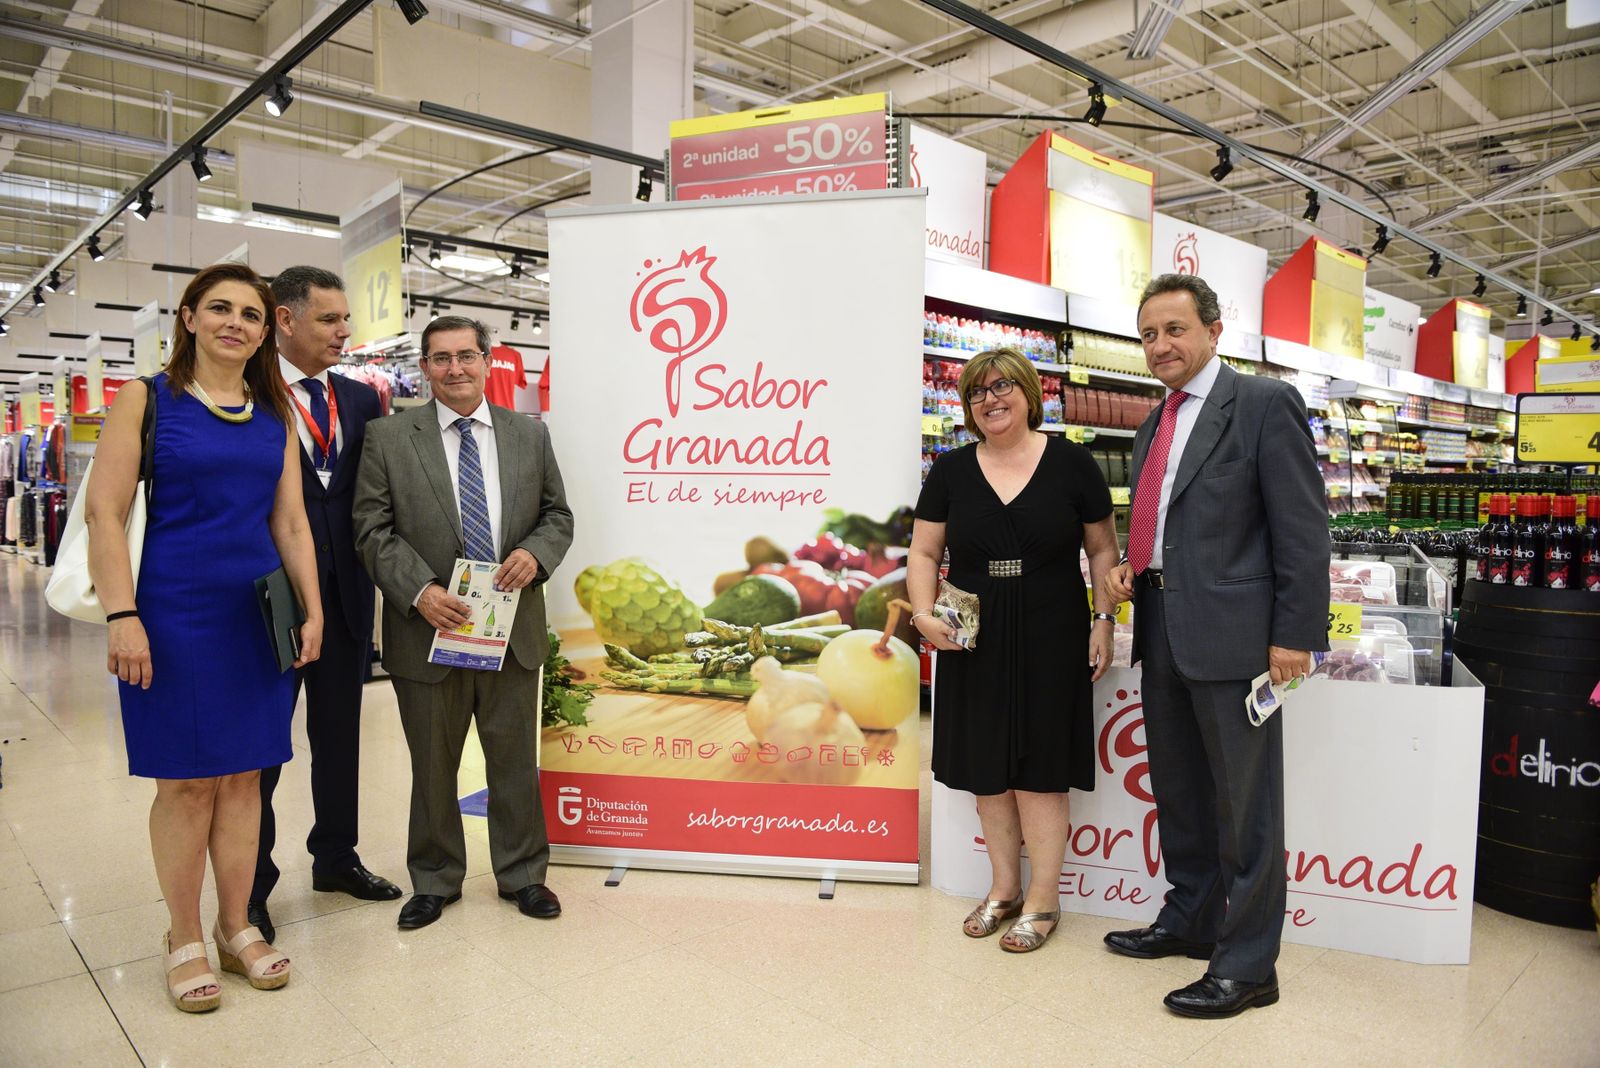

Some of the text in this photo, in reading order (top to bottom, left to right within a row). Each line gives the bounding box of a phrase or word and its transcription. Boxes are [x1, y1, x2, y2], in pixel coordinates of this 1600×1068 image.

[702, 143, 759, 165] unidad
[773, 122, 873, 164] -50%
[926, 228, 980, 259] anada
[366, 270, 389, 324] 12
[492, 359, 515, 372] BAJAS
[692, 361, 828, 411] Sabor
[623, 417, 831, 470] Granada
[626, 480, 827, 511] El de siempre
[1490, 734, 1600, 787] delirio
[586, 797, 648, 811] Diputación
[586, 811, 648, 825] de Granada
[686, 807, 889, 837] saborgranada.es
[1285, 843, 1457, 900] nada
[1103, 878, 1152, 905] de
